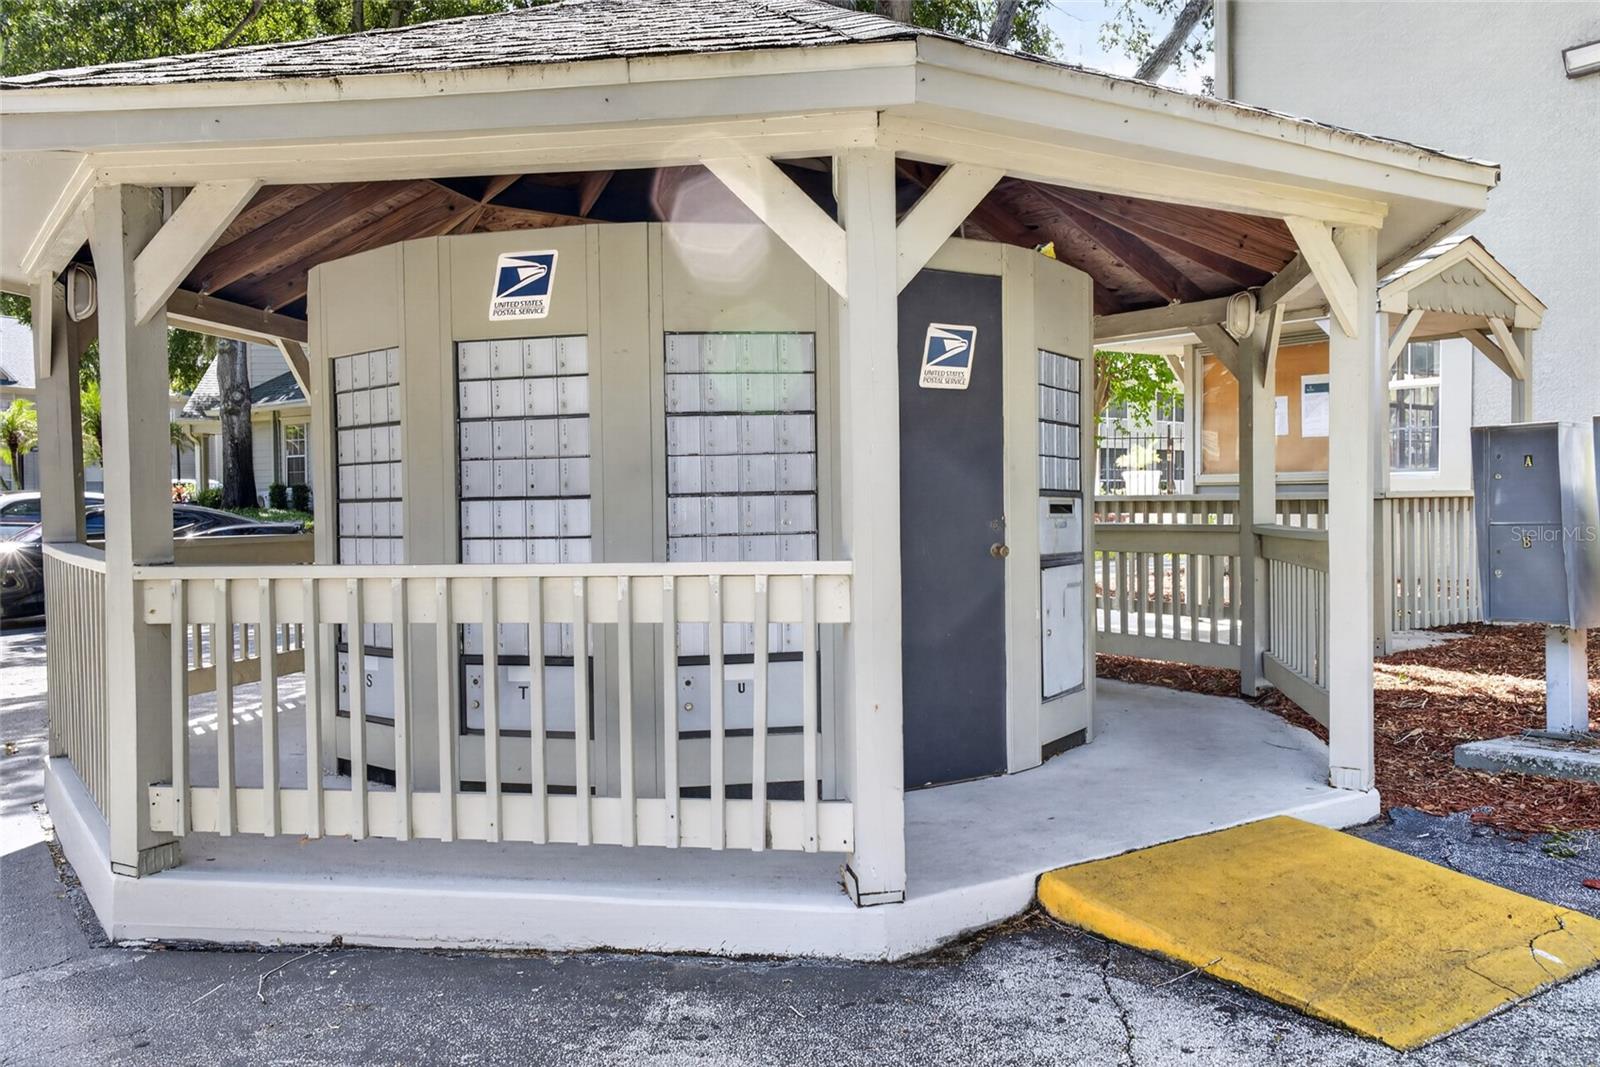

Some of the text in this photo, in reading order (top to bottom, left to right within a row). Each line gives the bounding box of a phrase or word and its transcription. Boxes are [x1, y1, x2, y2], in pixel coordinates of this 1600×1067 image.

[520, 299, 543, 307] STATES
[493, 307, 544, 316] POSTAL SERVICE
[1524, 455, 1533, 467] A
[1522, 536, 1532, 548] B
[366, 673, 373, 688] S
[518, 686, 529, 700] T
[737, 682, 746, 694] U
